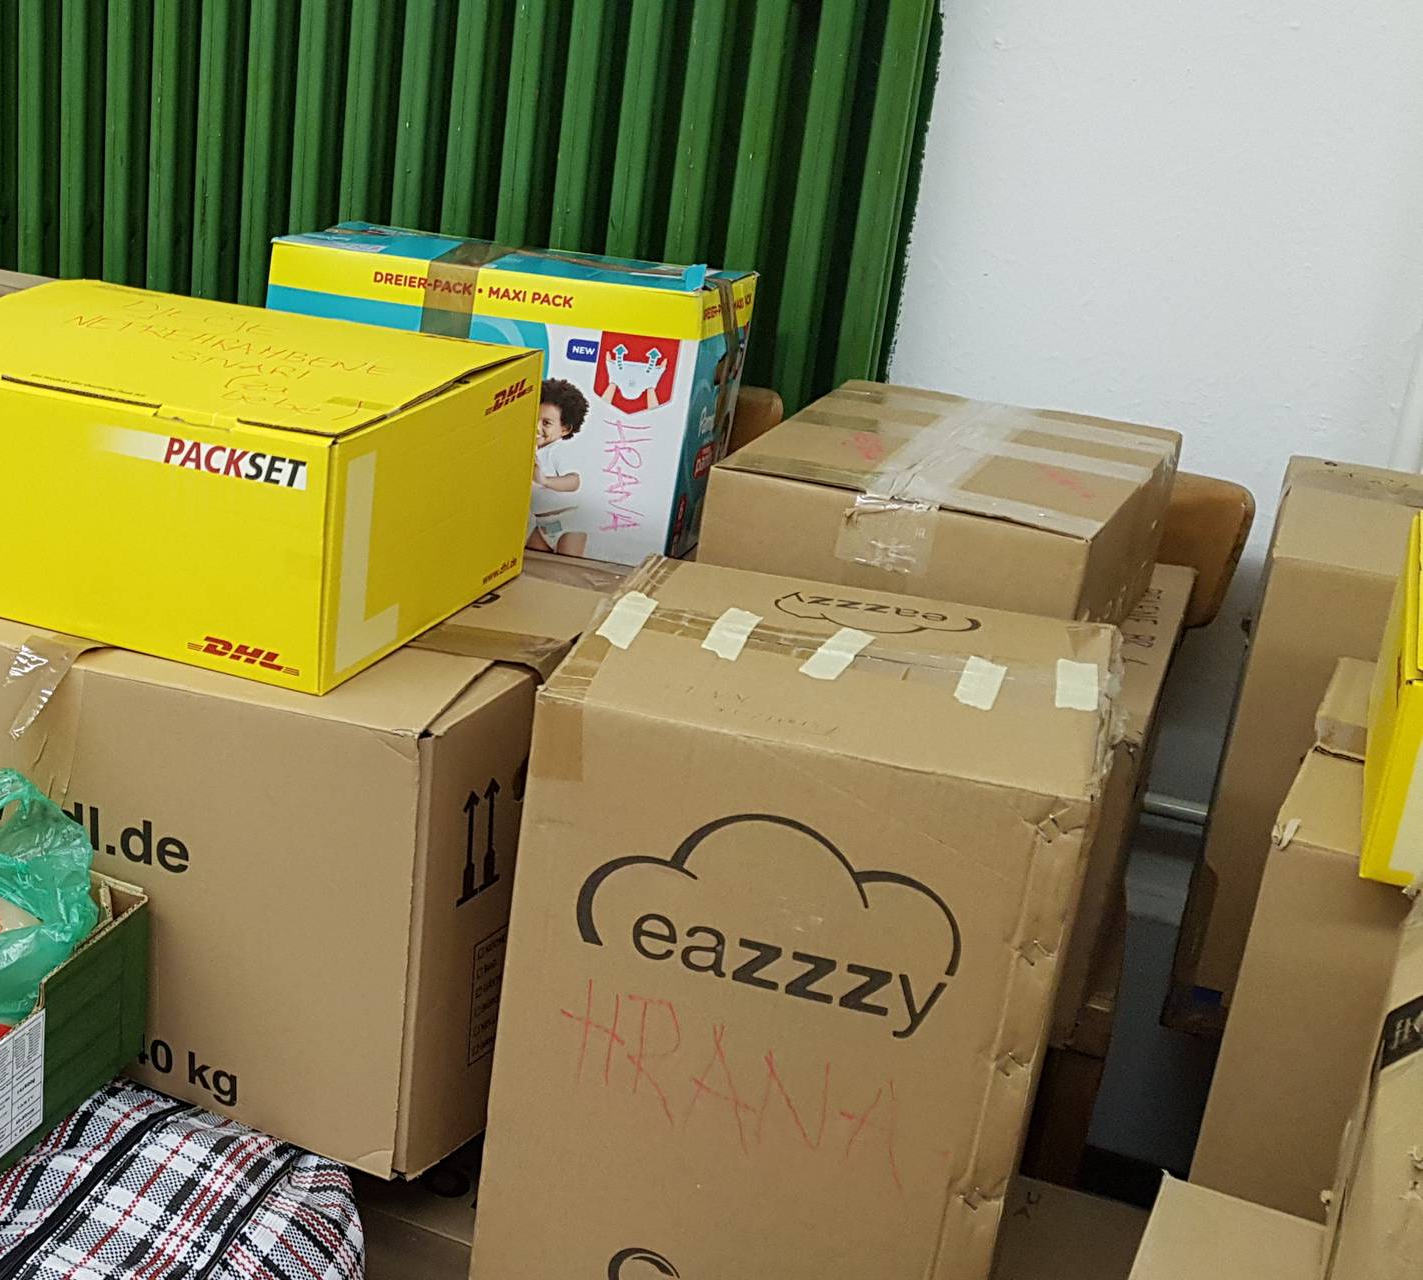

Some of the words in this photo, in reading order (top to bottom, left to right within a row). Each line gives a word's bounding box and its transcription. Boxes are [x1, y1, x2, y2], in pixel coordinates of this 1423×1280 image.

[373, 271, 473, 296] DREIER-PACK
[488, 286, 527, 303] MAXI
[531, 292, 575, 309] PACK
[572, 344, 595, 357] NEW
[491, 378, 528, 412] DHL
[163, 437, 307, 488] PACKSET
[781, 591, 948, 623] eazzzy
[201, 636, 285, 672] DHL
[632, 912, 948, 1039] eazzzy
[188, 1051, 238, 1106] kg
[560, 978, 904, 1197] HRANA
